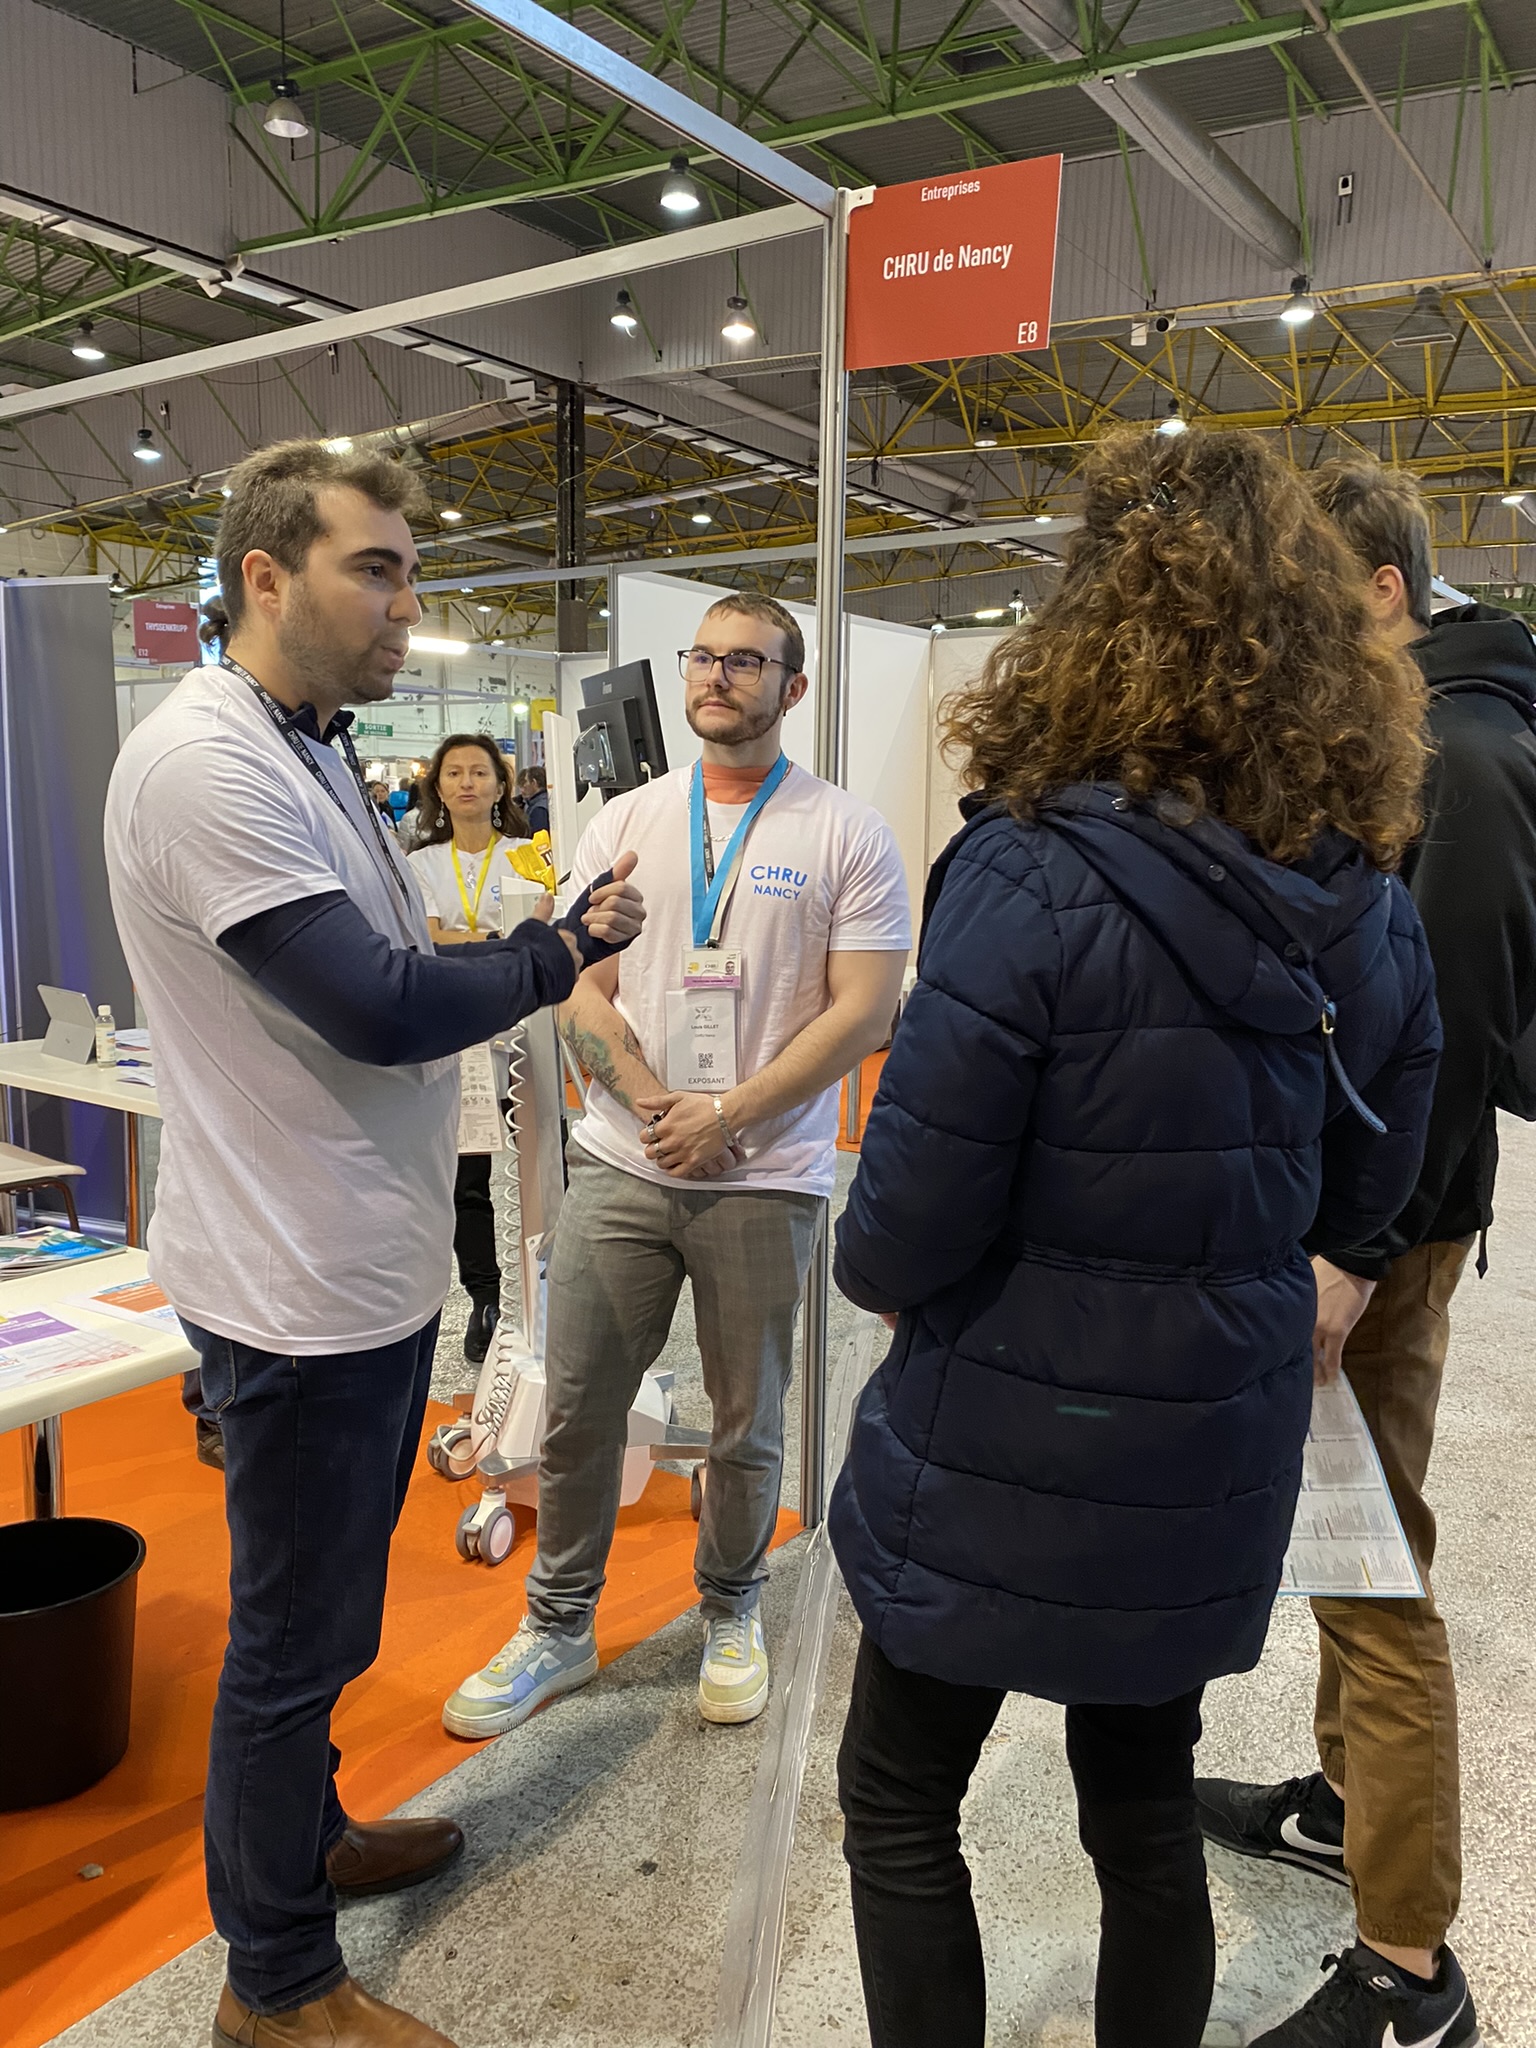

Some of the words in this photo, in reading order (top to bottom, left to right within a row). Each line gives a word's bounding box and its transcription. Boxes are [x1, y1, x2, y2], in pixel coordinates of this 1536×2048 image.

[921, 180, 981, 202] Entreprises
[883, 251, 929, 280] CHRU
[933, 249, 954, 272] de
[958, 243, 1013, 269] Nancy
[1017, 321, 1037, 344] E8
[138, 648, 148, 657] E12
[273, 709, 288, 725] NANCY
[301, 748, 315, 766] NANCY
[751, 865, 808, 887] CHRU
[754, 885, 801, 900] NANCY
[688, 1077, 725, 1085] EXPOSANT
